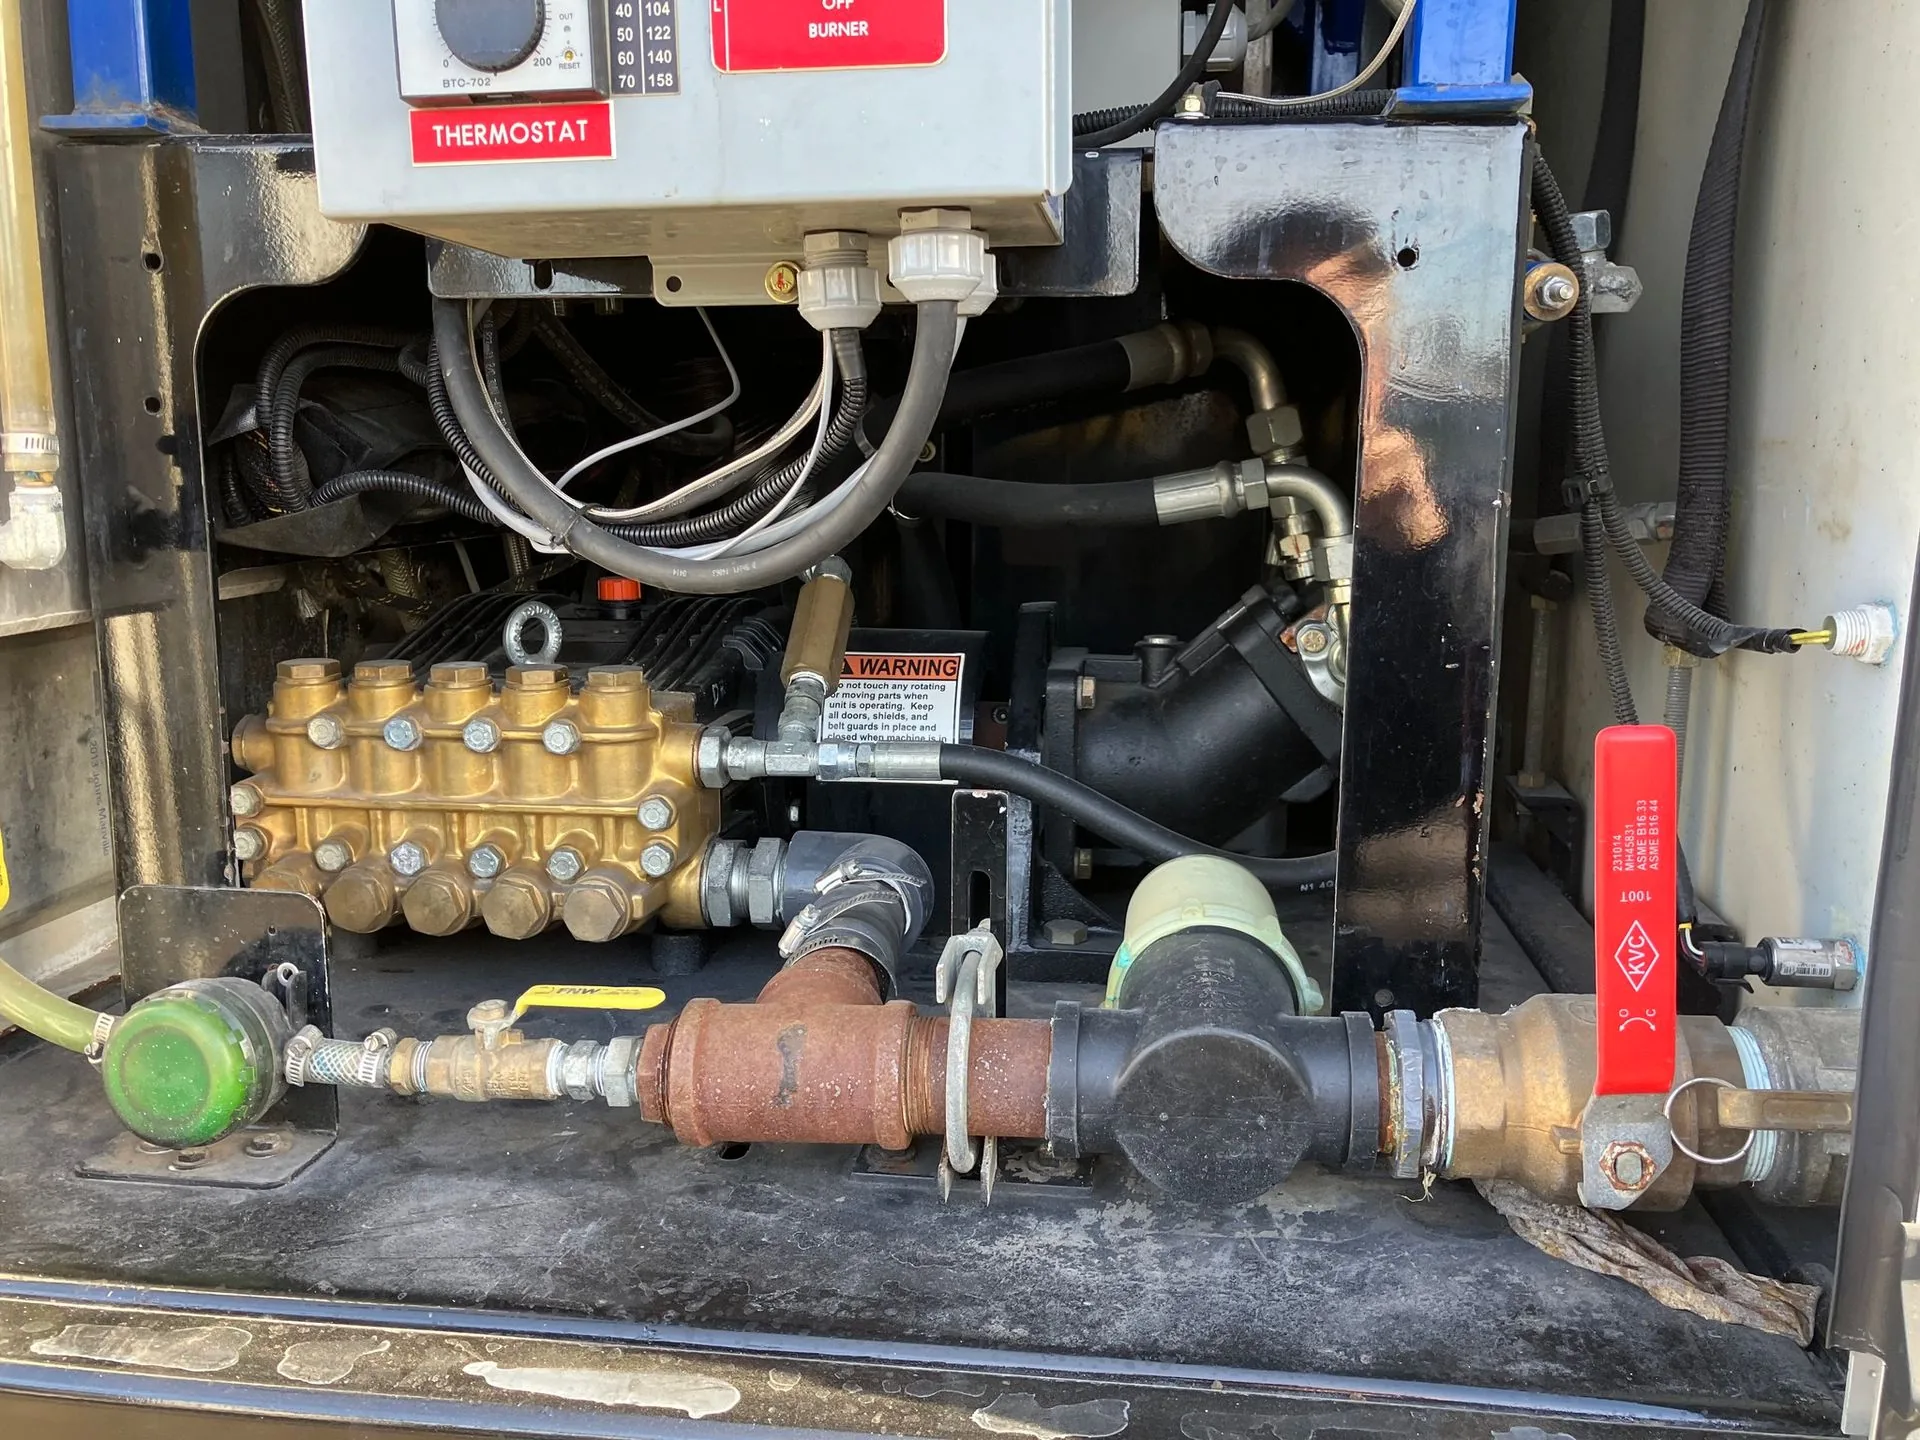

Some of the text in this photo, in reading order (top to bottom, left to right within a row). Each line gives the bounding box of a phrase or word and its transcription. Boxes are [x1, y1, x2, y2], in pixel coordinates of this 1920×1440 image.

[615, 1, 671, 18] 40 104
[821, 0, 855, 10] OFF
[559, 12, 573, 20] OUT
[616, 25, 672, 42] 50 122
[808, 20, 869, 38] BURNER
[533, 57, 552, 67] 200
[617, 49, 673, 66] 60 140
[442, 59, 449, 68] 0
[558, 61, 581, 70] RESET
[442, 77, 491, 89] BTC-702
[618, 72, 674, 89] 70 158
[432, 119, 589, 148] THERMOSTAT
[860, 658, 958, 676] WARNING
[863, 682, 889, 690] touch
[891, 683, 909, 692] any
[910, 683, 946, 692] rotating
[842, 691, 876, 701] moving
[878, 692, 902, 701] parts
[904, 692, 929, 700] when
[829, 701, 847, 709] unit
[859, 702, 906, 711] operating.
[910, 702, 934, 711] Keep
[828, 711, 839, 719] all
[841, 711, 870, 721] doors,
[872, 712, 909, 721] shields,
[828, 722, 937, 733] belt guards in place and
[827, 732, 858, 741] closed
[860, 733, 884, 742] when
[887, 734, 926, 742] machine
[1636, 799, 1648, 871] ASME B16.33
[1648, 799, 1660, 871] ASME B16.44
[1612, 834, 1623, 872] 231014
[1624, 823, 1635, 872] MH45831
[1619, 890, 1652, 902] 100T
[1627, 935, 1647, 976] KVC
[556, 987, 601, 995] FNW
[1618, 1008, 1629, 1018] O
[1645, 1008, 1657, 1018] C
